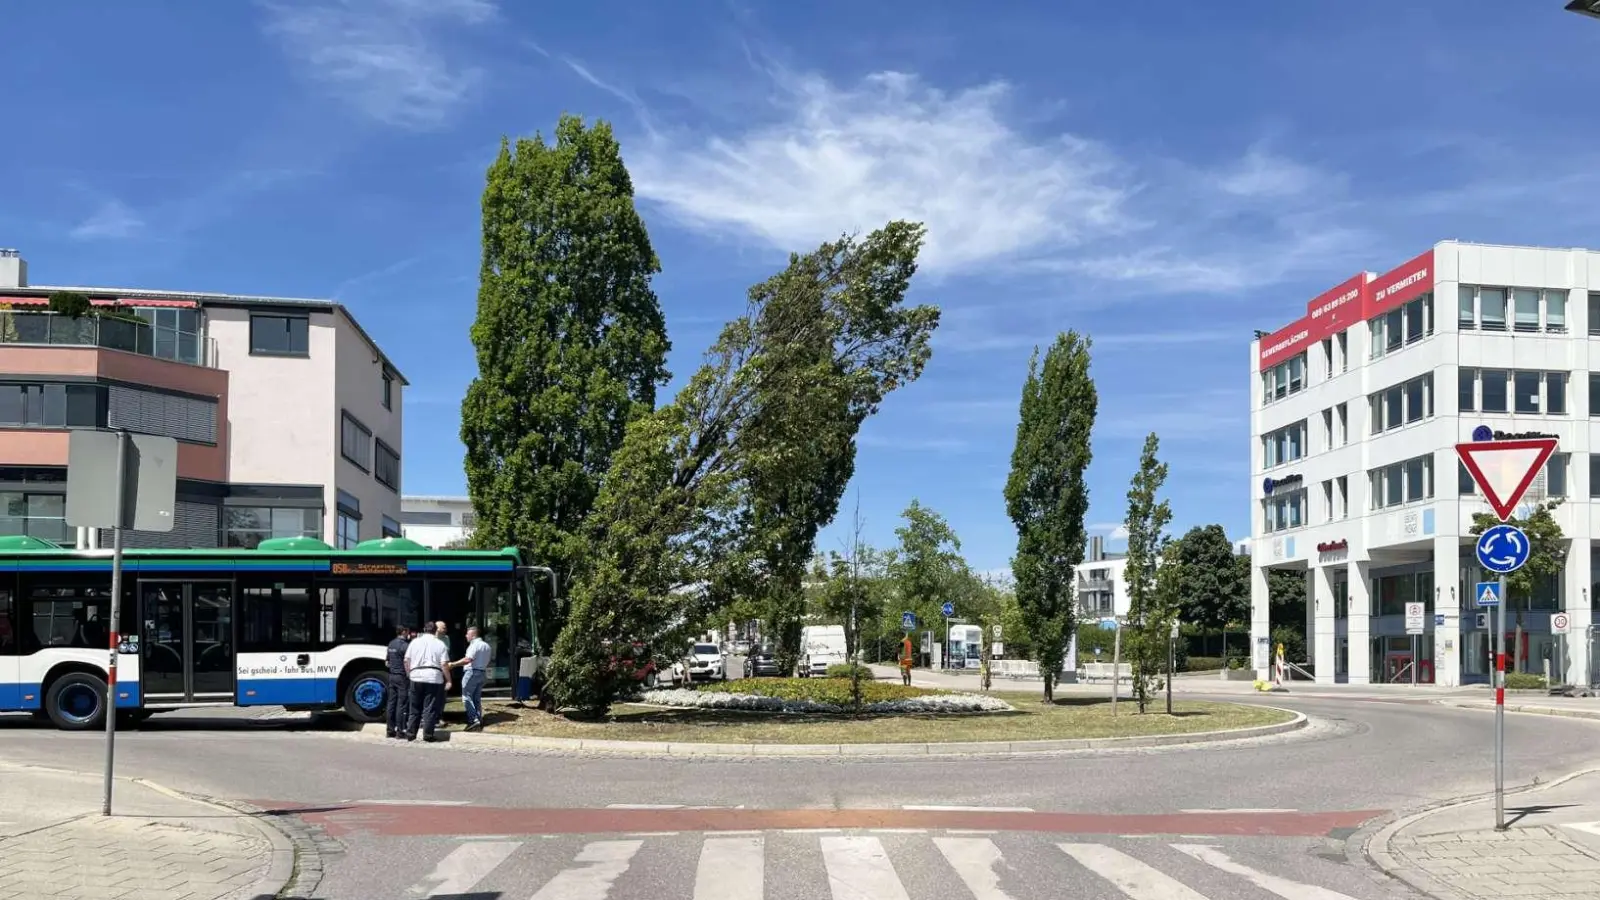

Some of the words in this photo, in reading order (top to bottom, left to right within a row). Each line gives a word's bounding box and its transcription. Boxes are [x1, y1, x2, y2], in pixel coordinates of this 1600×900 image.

[1376, 289, 1385, 302] ZU
[1387, 268, 1427, 295] VERMIETEN
[1262, 329, 1309, 358] GEWERBEFLÄCHEN
[1557, 618, 1565, 626] 30
[251, 666, 277, 676] gscheid
[285, 665, 299, 674] fahr
